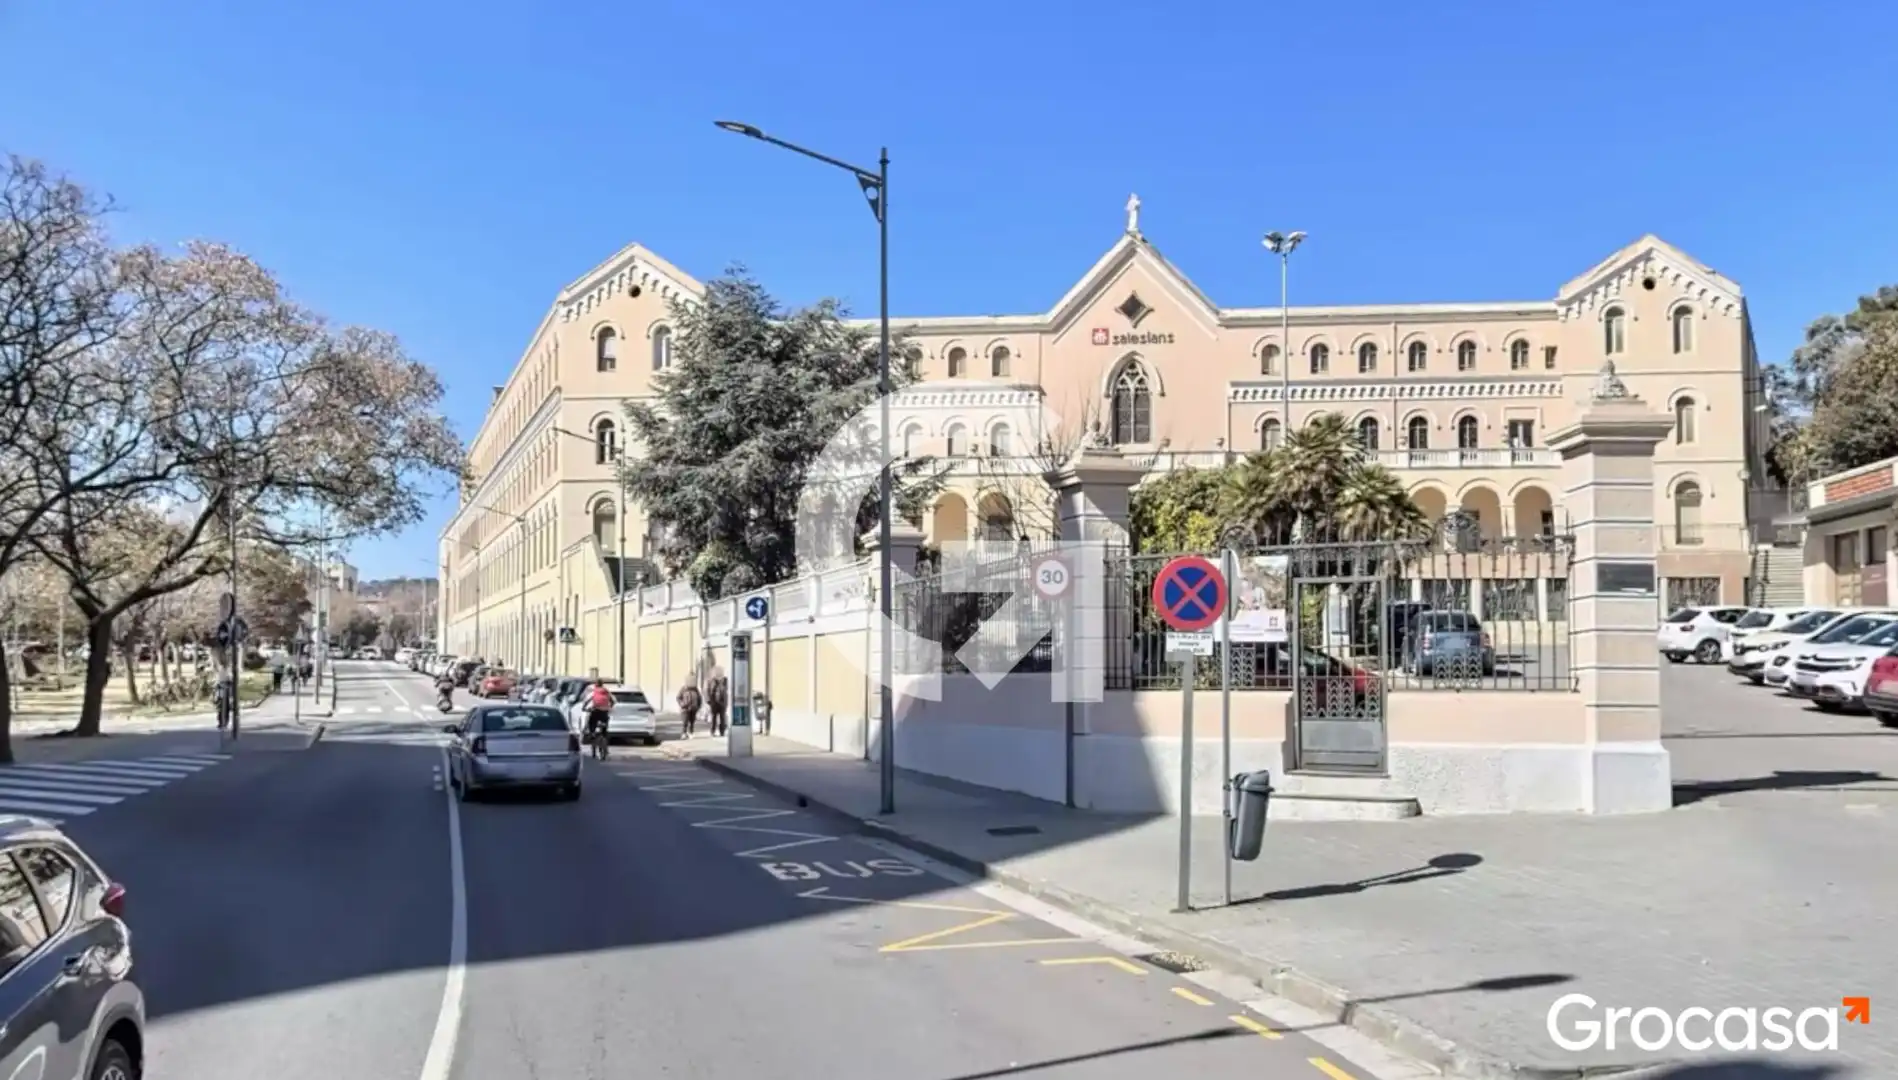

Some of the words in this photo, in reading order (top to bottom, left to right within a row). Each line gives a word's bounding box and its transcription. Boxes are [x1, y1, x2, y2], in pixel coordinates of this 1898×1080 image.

[1113, 331, 1175, 345] salesians
[1041, 569, 1064, 585] 30
[760, 859, 925, 881] BUS
